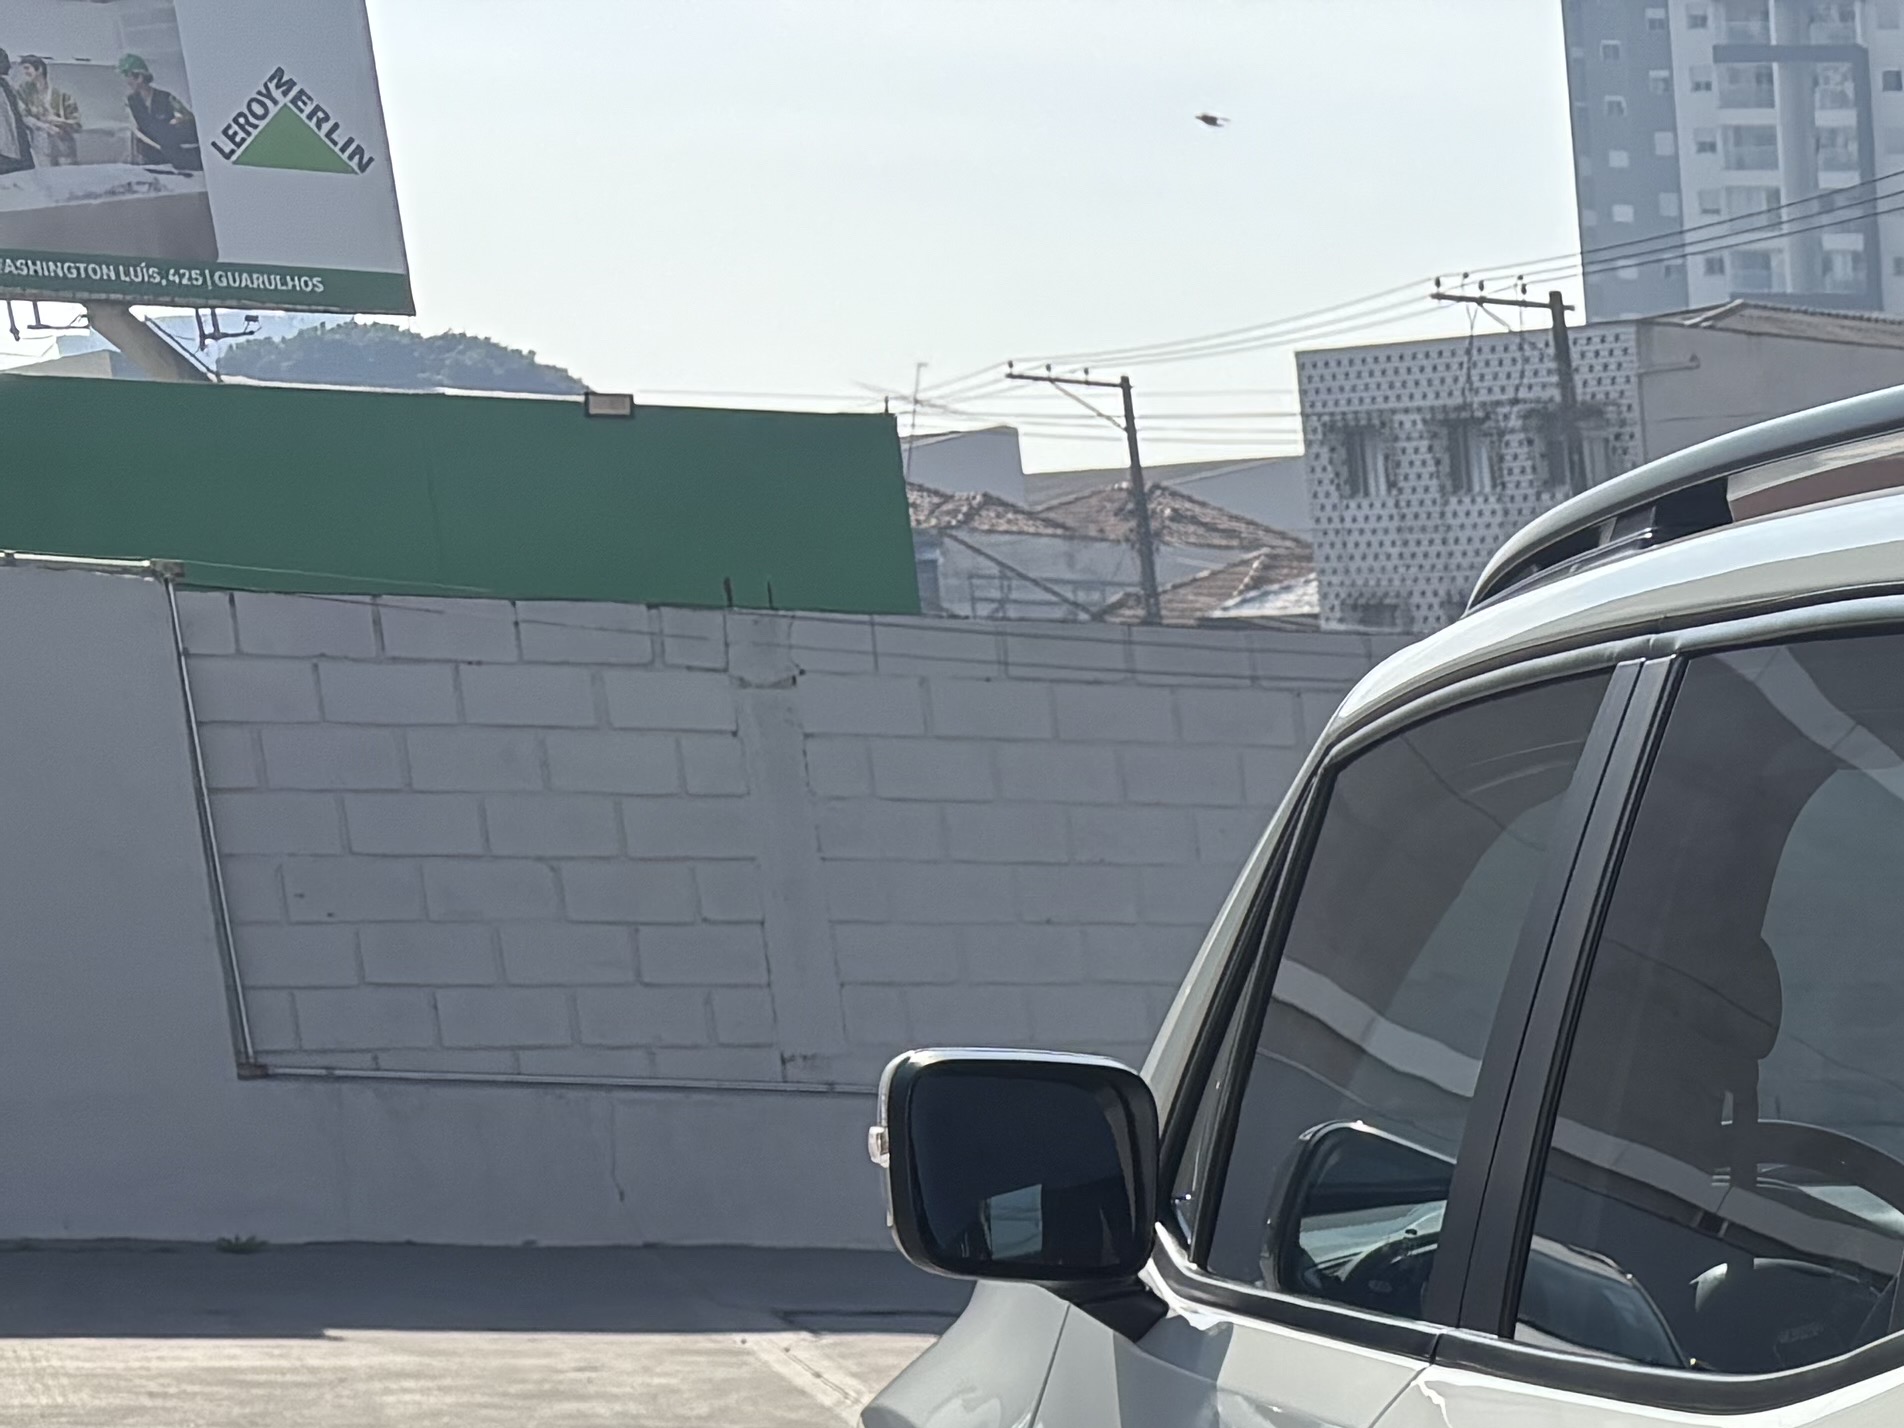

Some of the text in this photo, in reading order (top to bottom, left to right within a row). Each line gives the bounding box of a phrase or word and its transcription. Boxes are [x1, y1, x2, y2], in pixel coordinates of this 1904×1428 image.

[210, 66, 375, 174] LEROY MERLIN
[0, 258, 116, 280] ASHINGTON
[168, 269, 202, 286] 425
[214, 271, 325, 293] GUARULHOS
